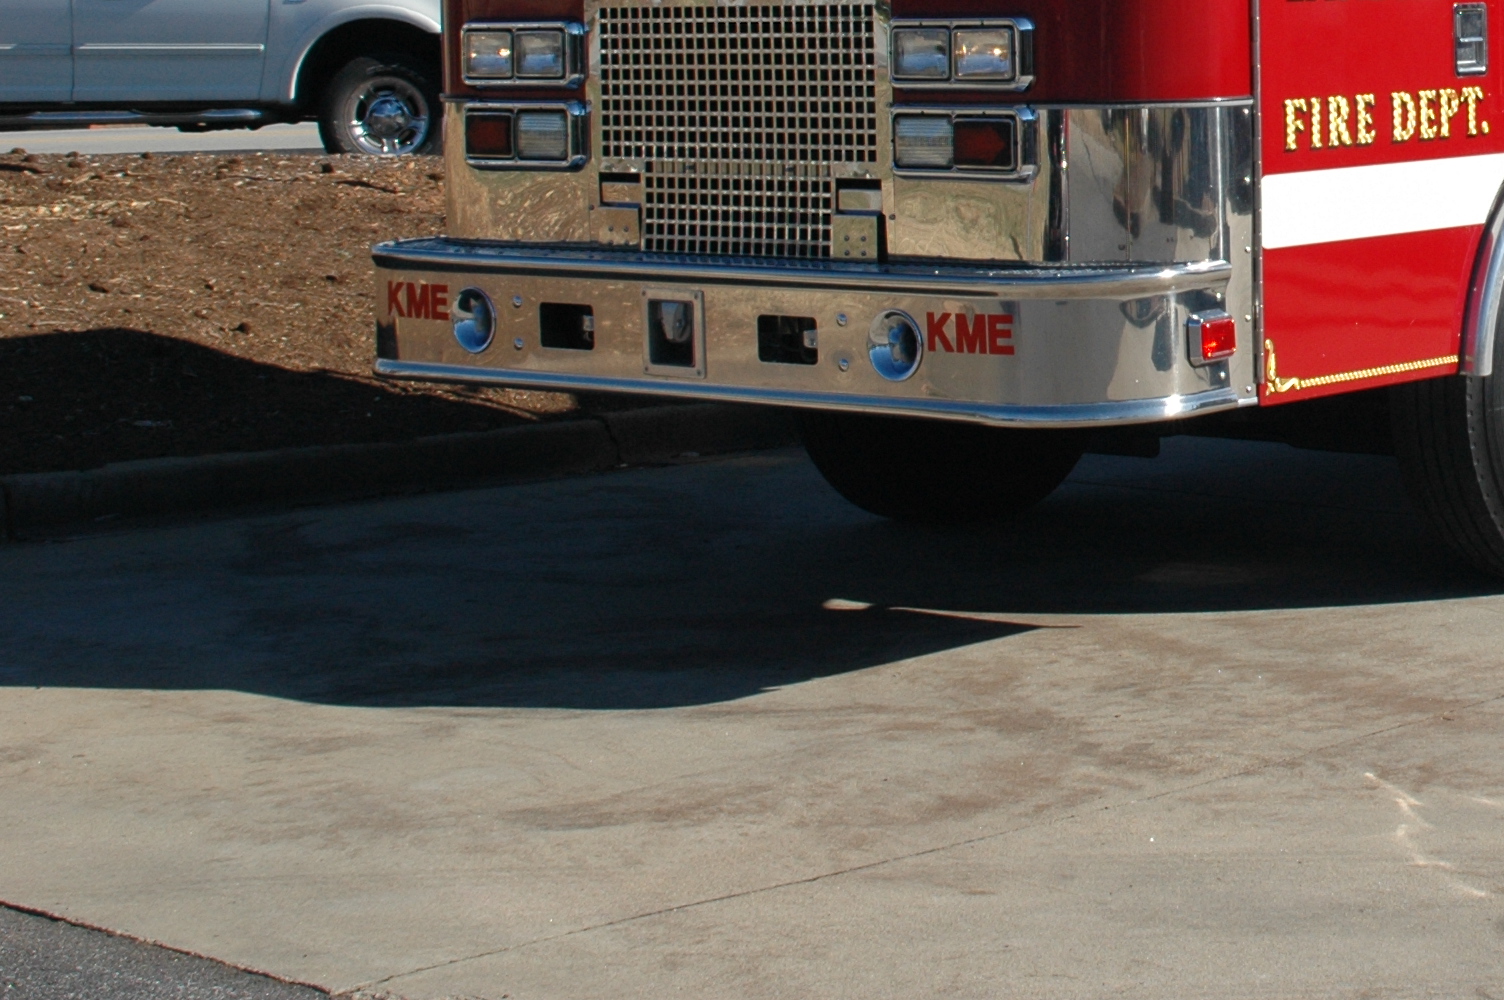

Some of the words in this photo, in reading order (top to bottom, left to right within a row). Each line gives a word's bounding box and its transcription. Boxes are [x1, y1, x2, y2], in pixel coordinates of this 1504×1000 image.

[1284, 94, 1377, 151] FIRE
[1390, 86, 1490, 143] DEPT.
[387, 280, 450, 322] KME
[926, 311, 1016, 356] KME
